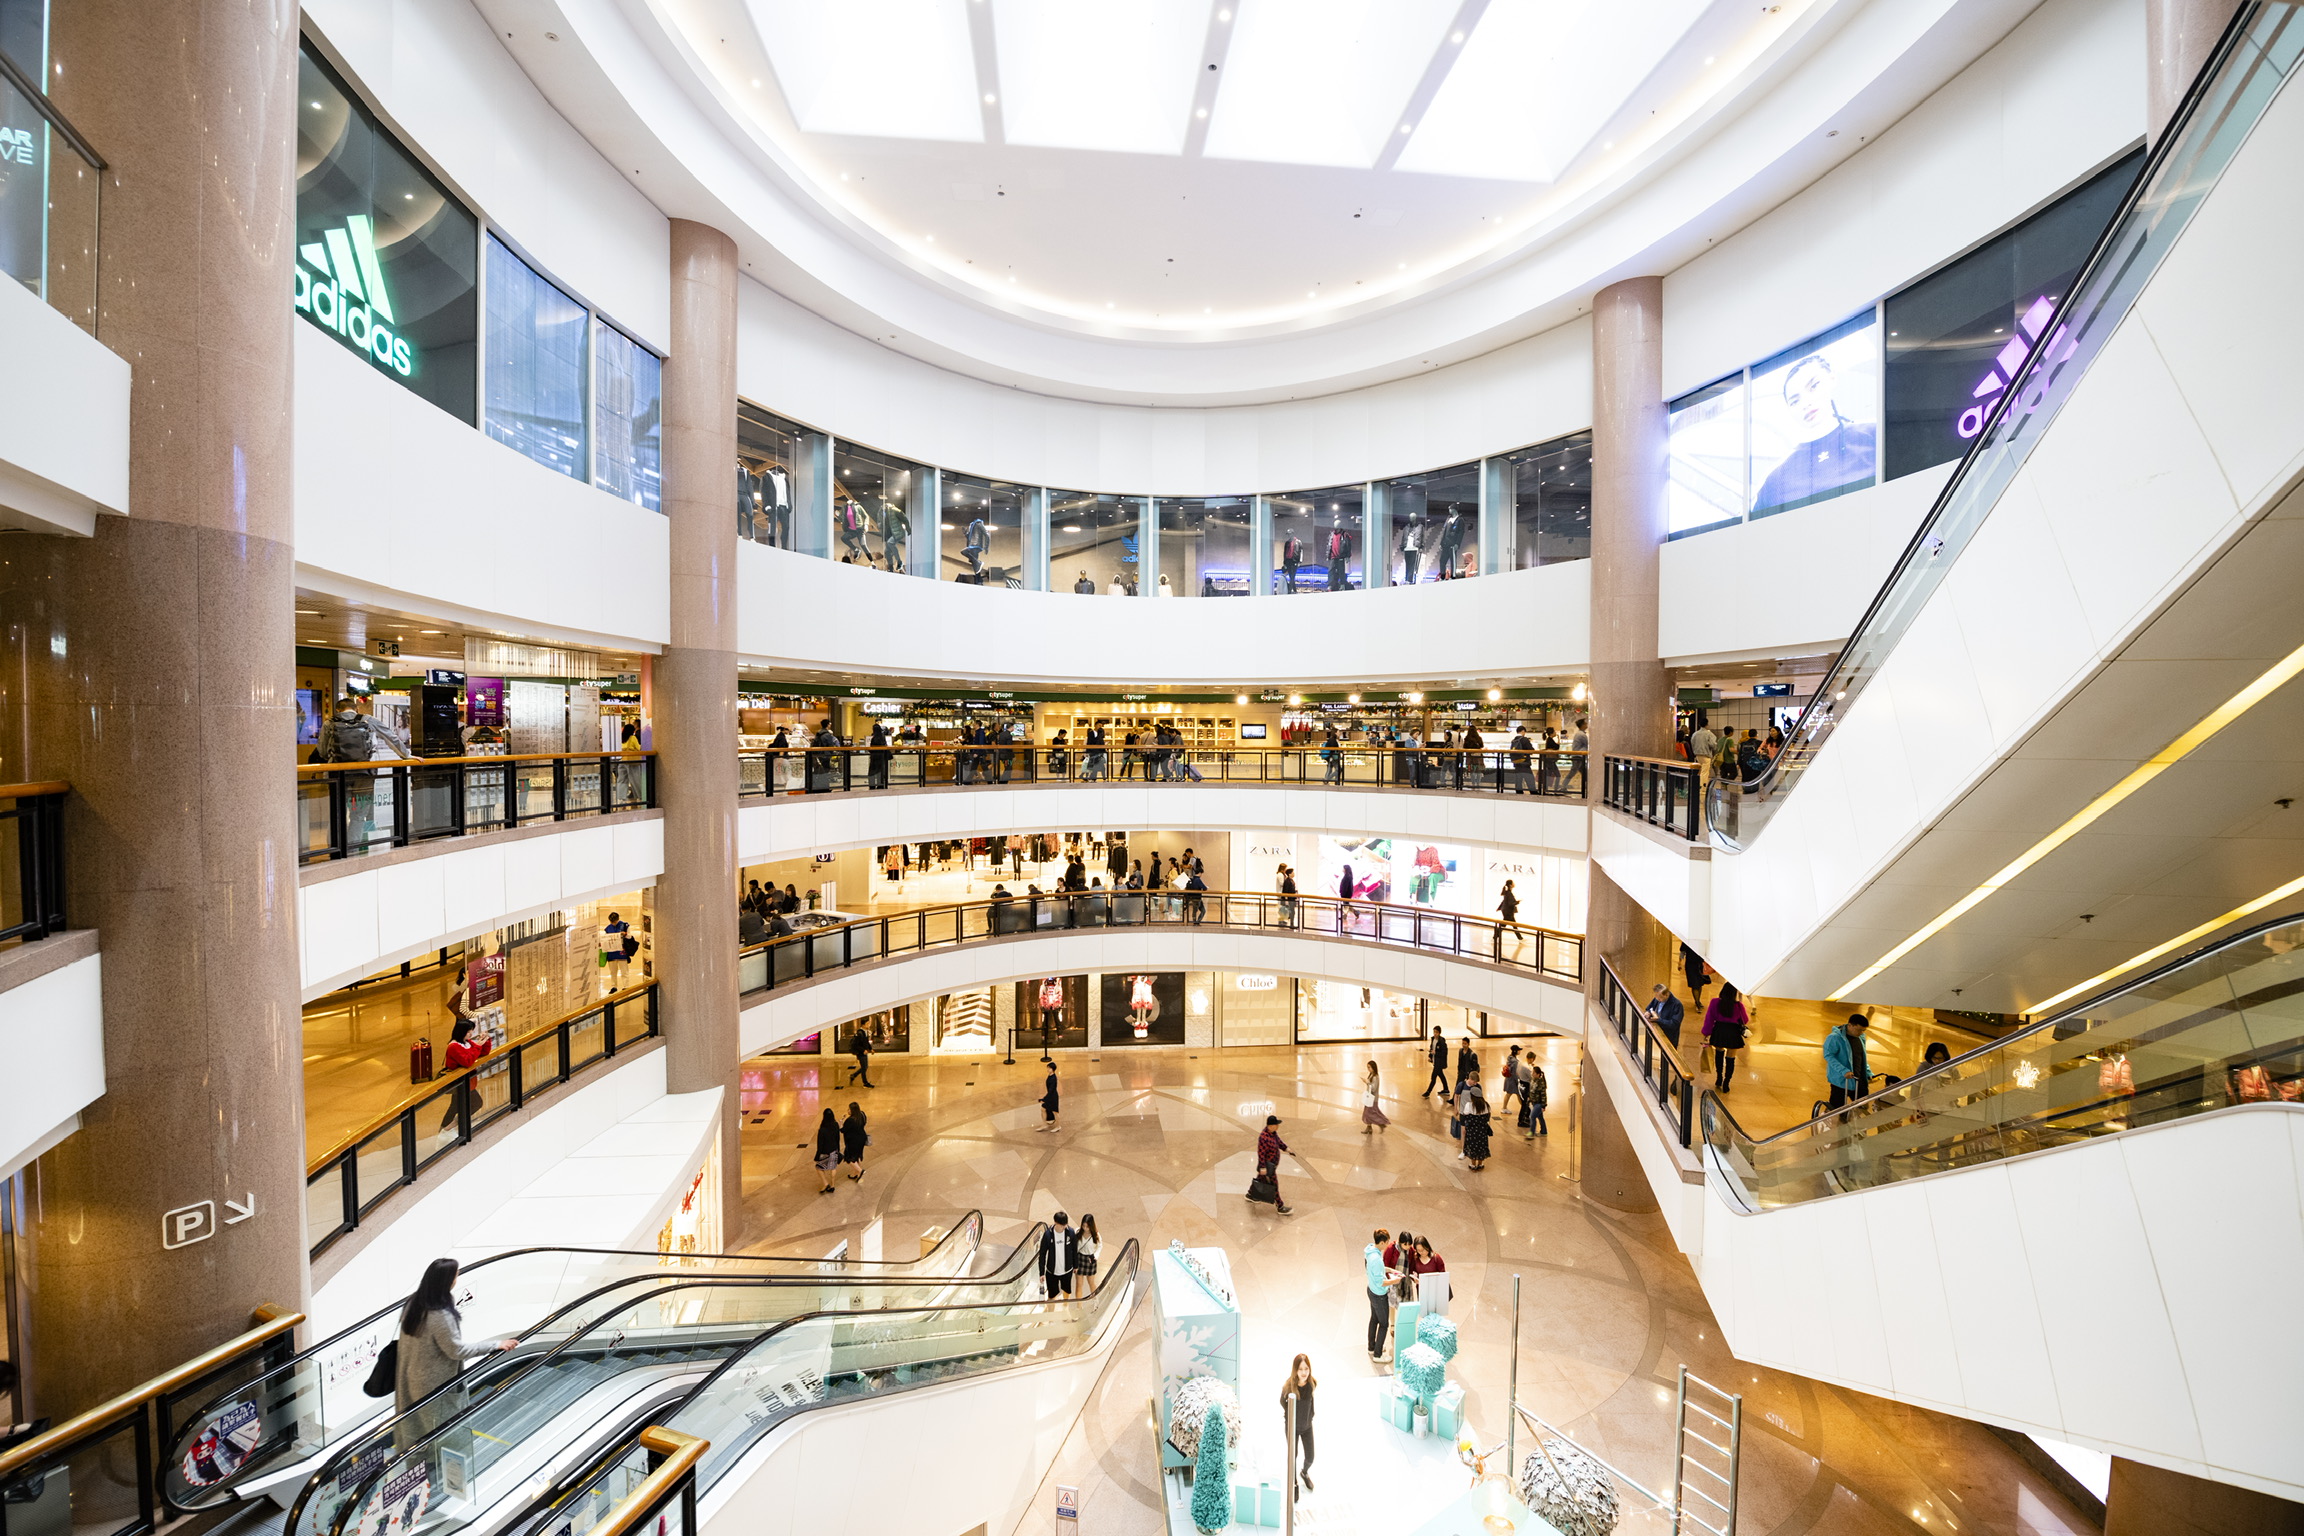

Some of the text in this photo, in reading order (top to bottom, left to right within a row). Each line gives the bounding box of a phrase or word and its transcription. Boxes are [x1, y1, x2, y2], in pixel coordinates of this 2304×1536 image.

[295, 263, 411, 376] adidas
[579, 680, 612, 688] citysuper
[850, 687, 876, 695] citysuper
[752, 699, 771, 709] Deli
[863, 702, 901, 713] Cashier
[1250, 846, 1292, 856] ZARA
[1489, 861, 1536, 875] ZARA
[1241, 977, 1273, 988] Chloé
[176, 1210, 204, 1242] P
